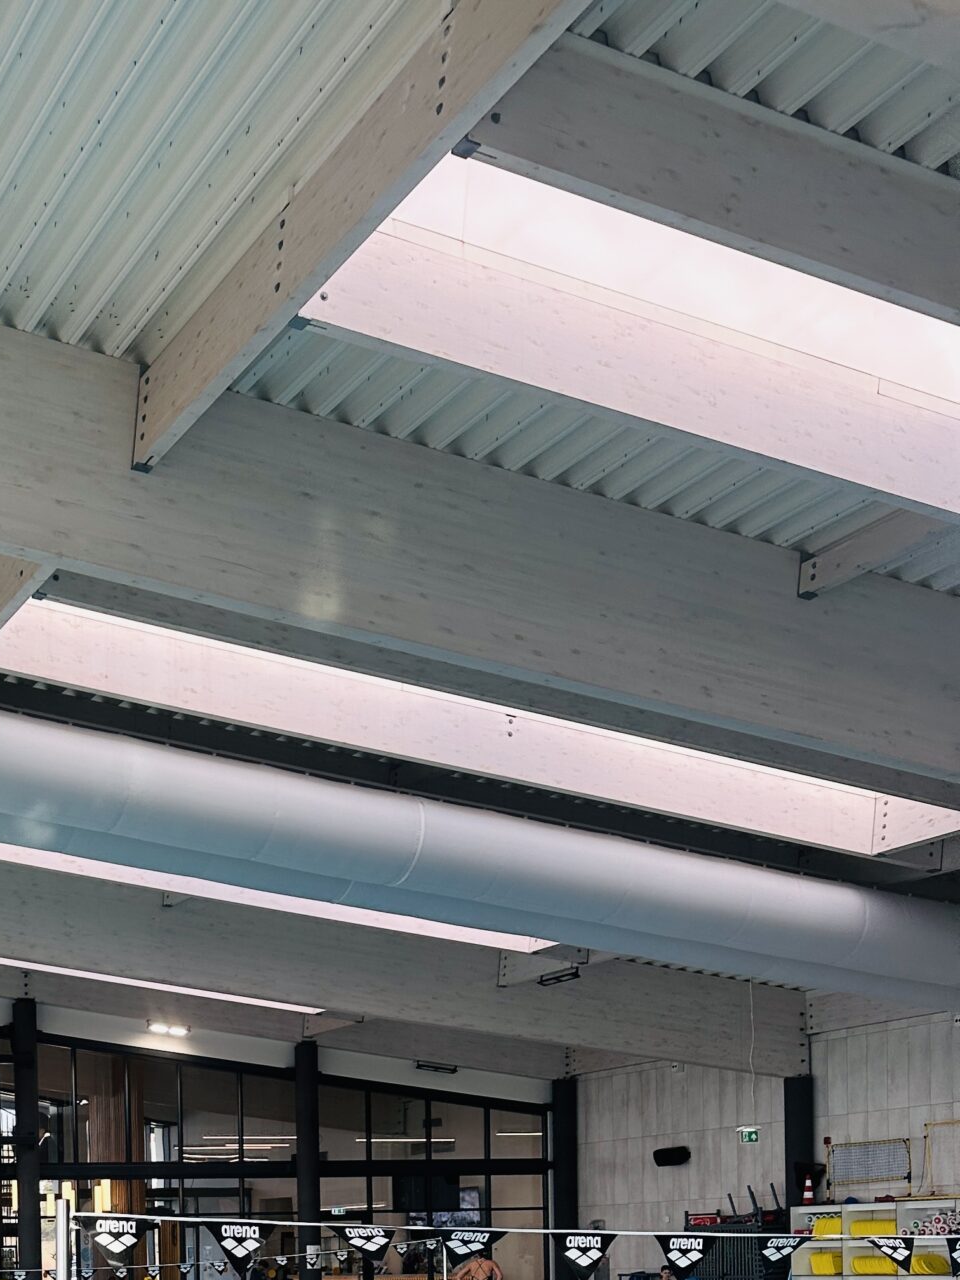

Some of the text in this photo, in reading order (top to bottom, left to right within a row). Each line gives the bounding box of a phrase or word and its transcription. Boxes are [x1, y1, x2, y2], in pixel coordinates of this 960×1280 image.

[95, 1219, 137, 1234] arena
[221, 1224, 260, 1239] arena
[345, 1226, 385, 1239] arena
[450, 1230, 490, 1243] arena
[566, 1235, 602, 1249] arena
[766, 1237, 799, 1247] arena
[669, 1237, 703, 1250] arena
